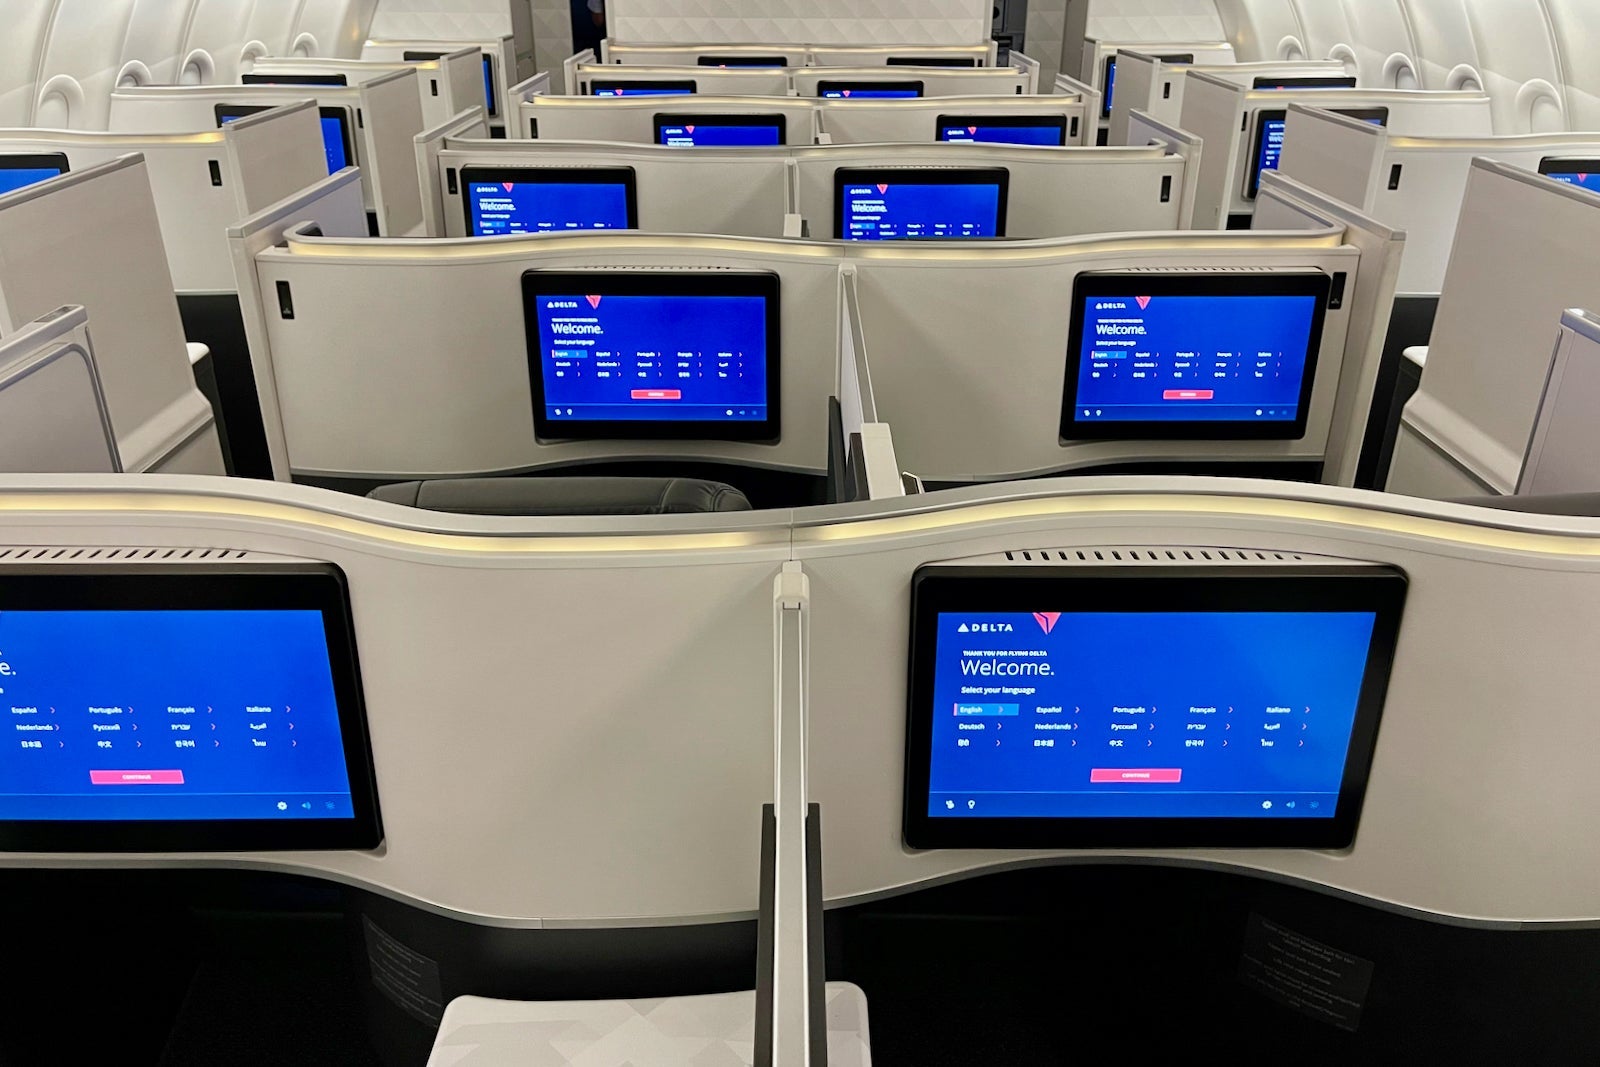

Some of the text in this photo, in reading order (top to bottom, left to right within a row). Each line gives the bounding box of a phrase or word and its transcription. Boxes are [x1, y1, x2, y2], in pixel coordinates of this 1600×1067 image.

[479, 202, 516, 211] Welcome.
[851, 203, 888, 213] Welcome.
[551, 322, 604, 335] Welcome.
[1095, 323, 1147, 335] Welcome.
[971, 623, 1013, 632] DELTA
[960, 658, 1055, 676] Welcome.
[960, 686, 1036, 696] Select your language
[11, 706, 38, 715] Español
[88, 706, 123, 715] Português
[167, 706, 196, 714] Français
[959, 706, 983, 715] English
[1036, 706, 1062, 714] Español
[1112, 706, 1146, 715] Português
[1189, 706, 1217, 714] Français
[1110, 723, 1138, 731] Русский
